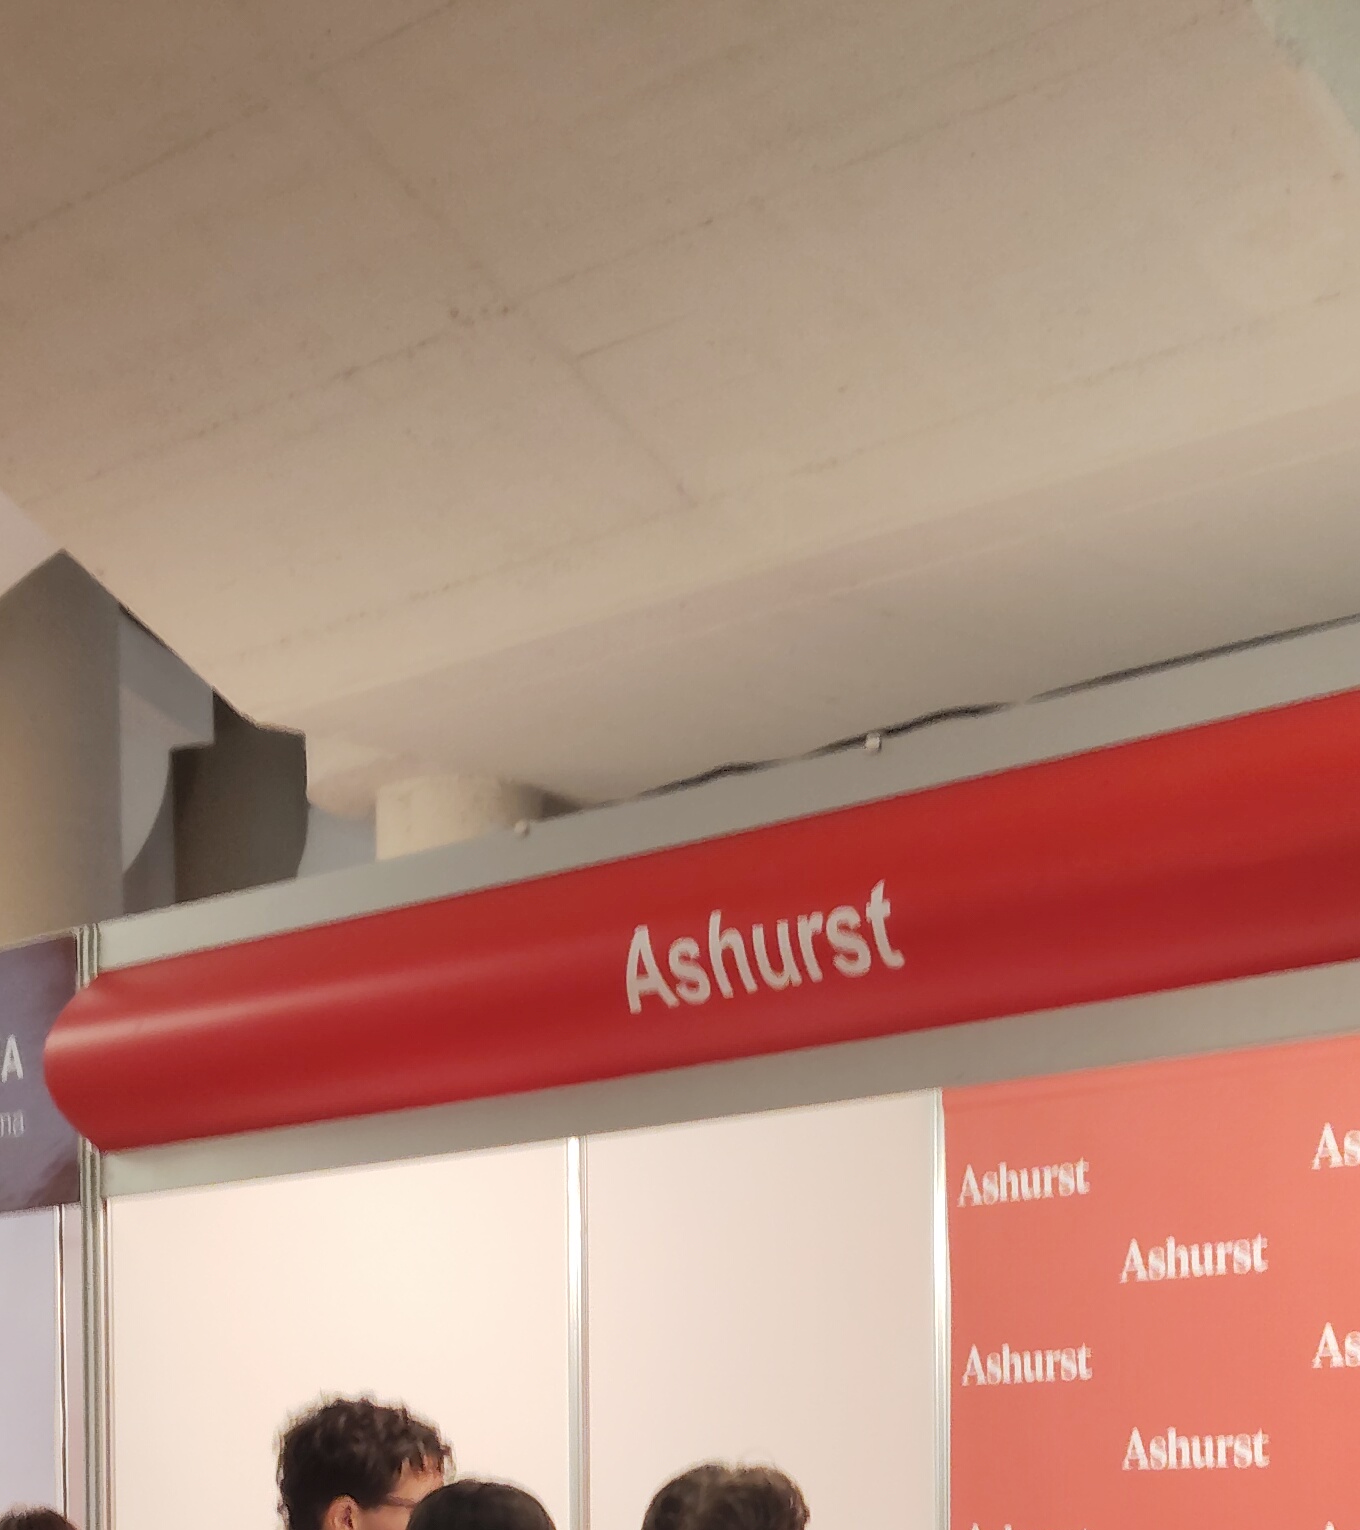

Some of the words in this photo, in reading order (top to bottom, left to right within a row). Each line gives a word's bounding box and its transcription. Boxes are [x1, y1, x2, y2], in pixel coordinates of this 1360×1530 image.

[626, 879, 905, 1014] Ashurst
[957, 1157, 1090, 1207] Ashurst
[1119, 1233, 1269, 1284] Ashurst
[961, 1342, 1093, 1386] Ashurst
[1121, 1427, 1270, 1471] Ashurst
